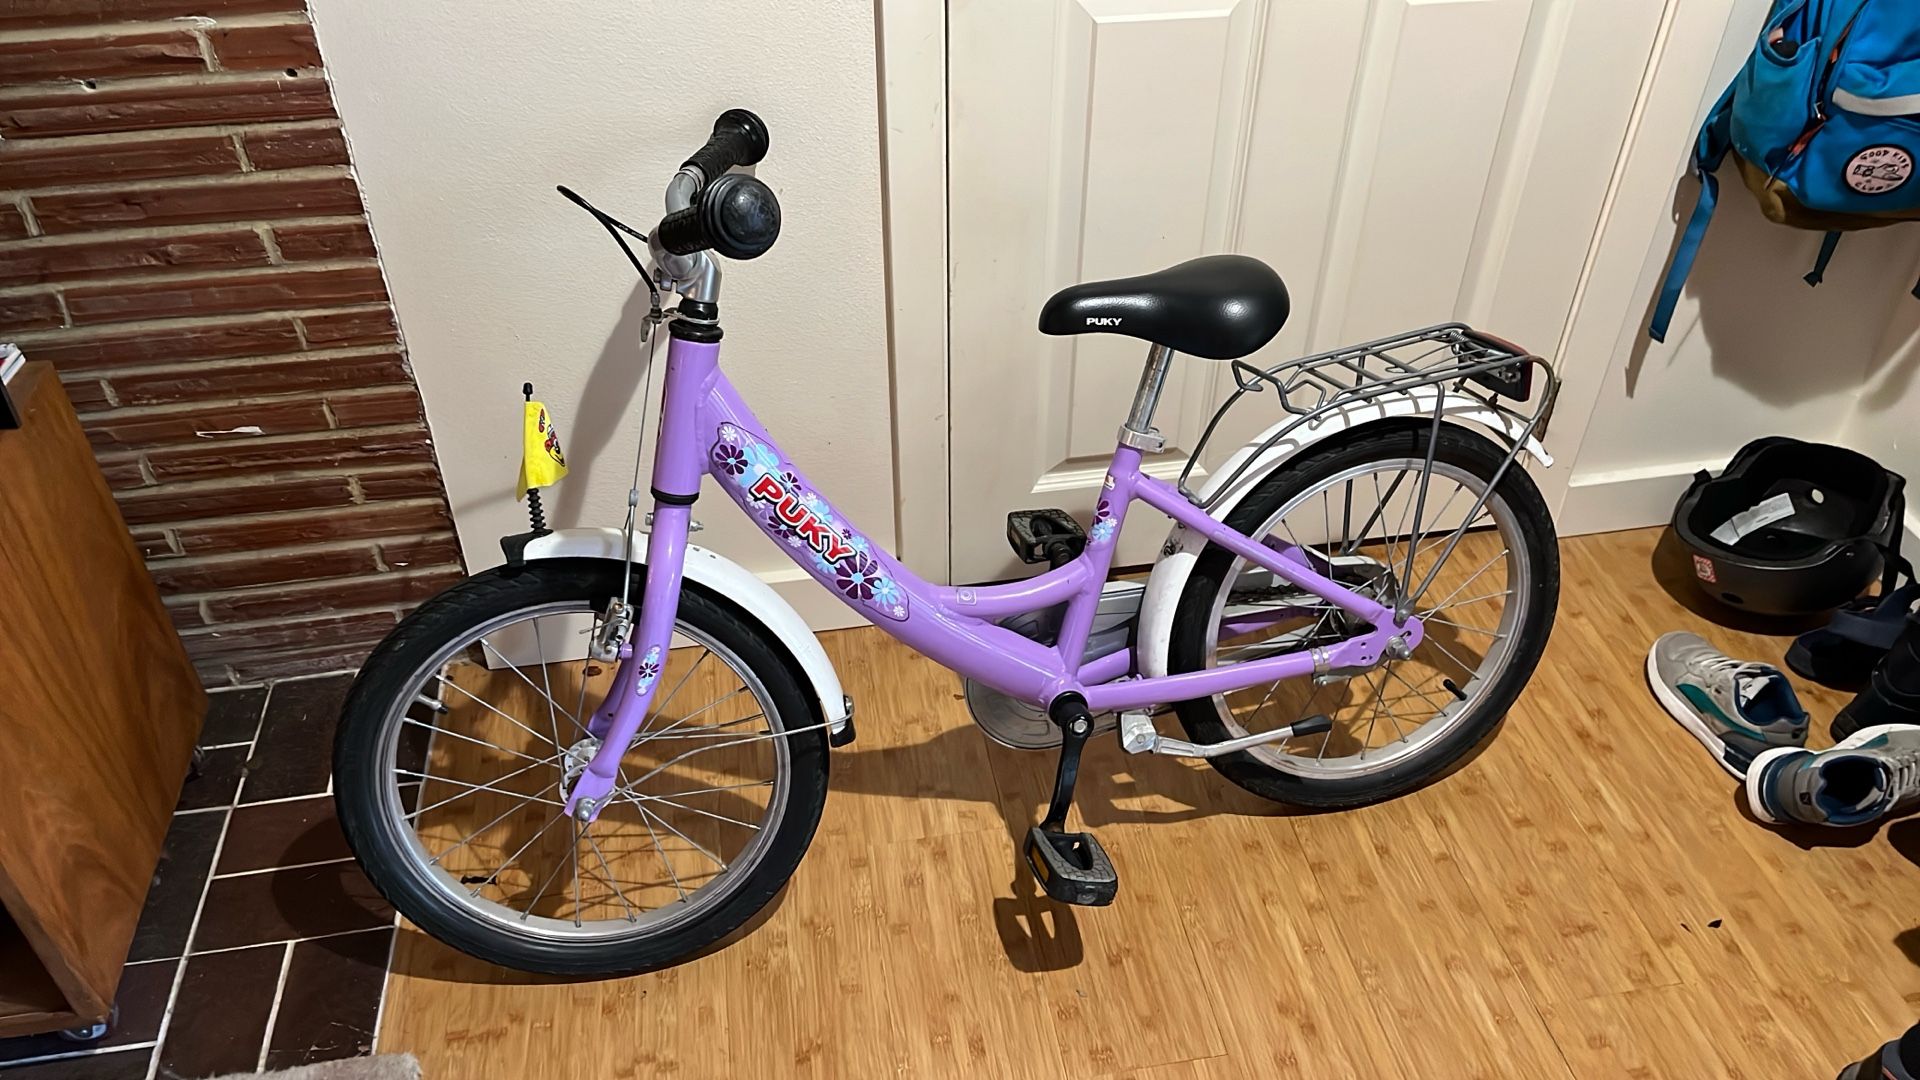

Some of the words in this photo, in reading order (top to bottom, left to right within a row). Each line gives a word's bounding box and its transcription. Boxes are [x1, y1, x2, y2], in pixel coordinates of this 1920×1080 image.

[1860, 150, 1890, 160] GOOD
[1086, 317, 1122, 326] PUKY
[750, 472, 857, 564] PUKY
